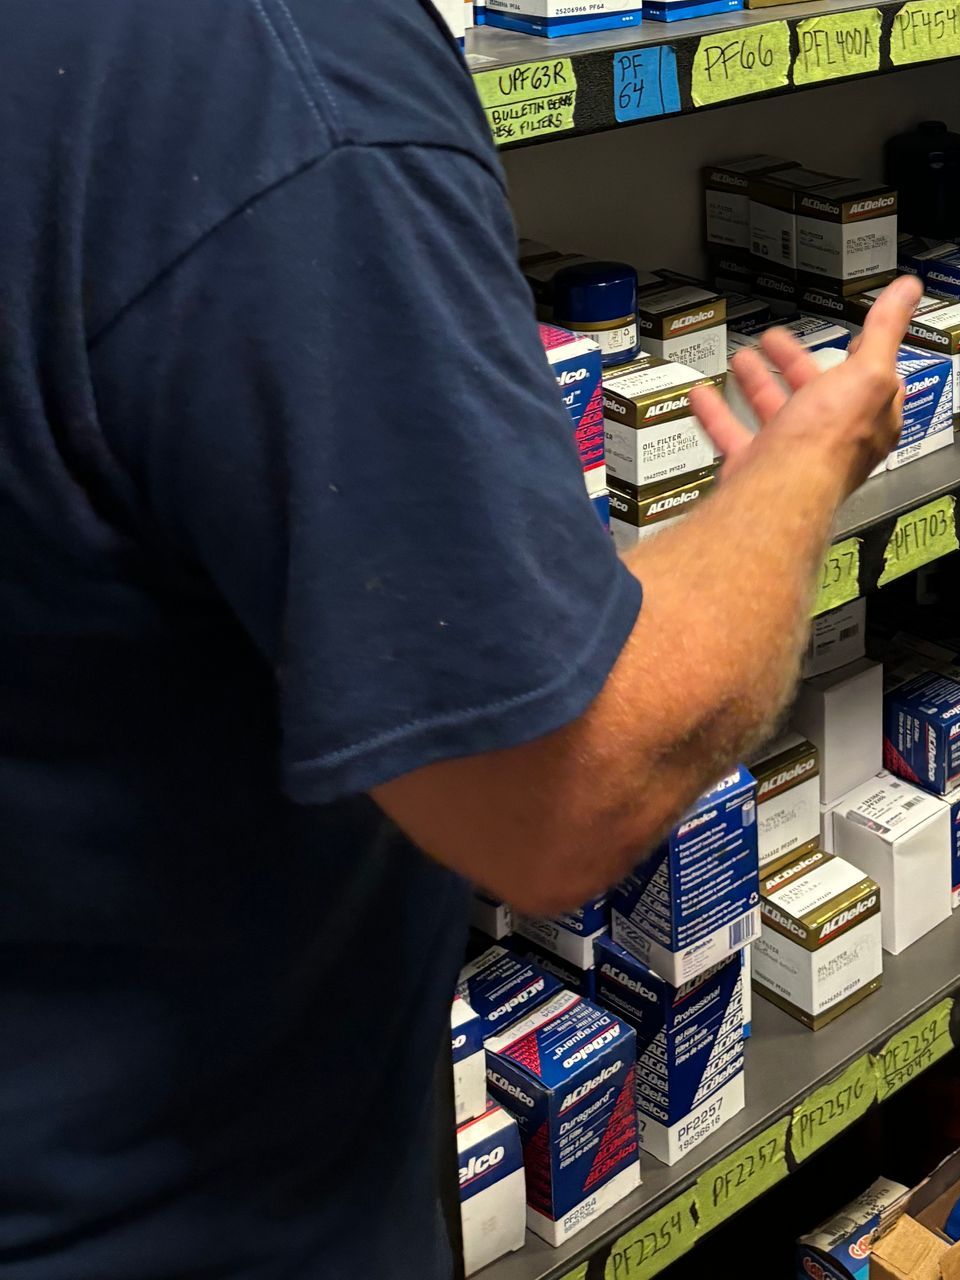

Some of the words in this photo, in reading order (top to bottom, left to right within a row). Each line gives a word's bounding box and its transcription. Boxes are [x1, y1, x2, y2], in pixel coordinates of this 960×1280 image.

[900, 8, 957, 47] PF454
[618, 54, 642, 77] PF
[704, 34, 773, 81] PF66
[801, 28, 874, 73] PFL400A
[498, 62, 565, 96] UPF63R
[619, 82, 644, 109] 64
[492, 101, 544, 124] BULLETIN
[520, 113, 562, 134] FILTERS
[850, 197, 894, 214] ACDelco
[670, 310, 714, 330] ACDelco
[646, 399, 689, 418] ACDelc
[643, 441, 655, 450] OIL
[657, 433, 682, 445] FILTER
[647, 490, 699, 516] ACDelco
[894, 510, 947, 560] PF1703
[674, 986, 721, 1025] Professional
[883, 1021, 938, 1072] PF2259
[677, 1098, 724, 1141] PF2257
[800, 1078, 864, 1147] PF2257G
[712, 1139, 777, 1207] PF2257
[612, 1212, 682, 1275] PF2254
